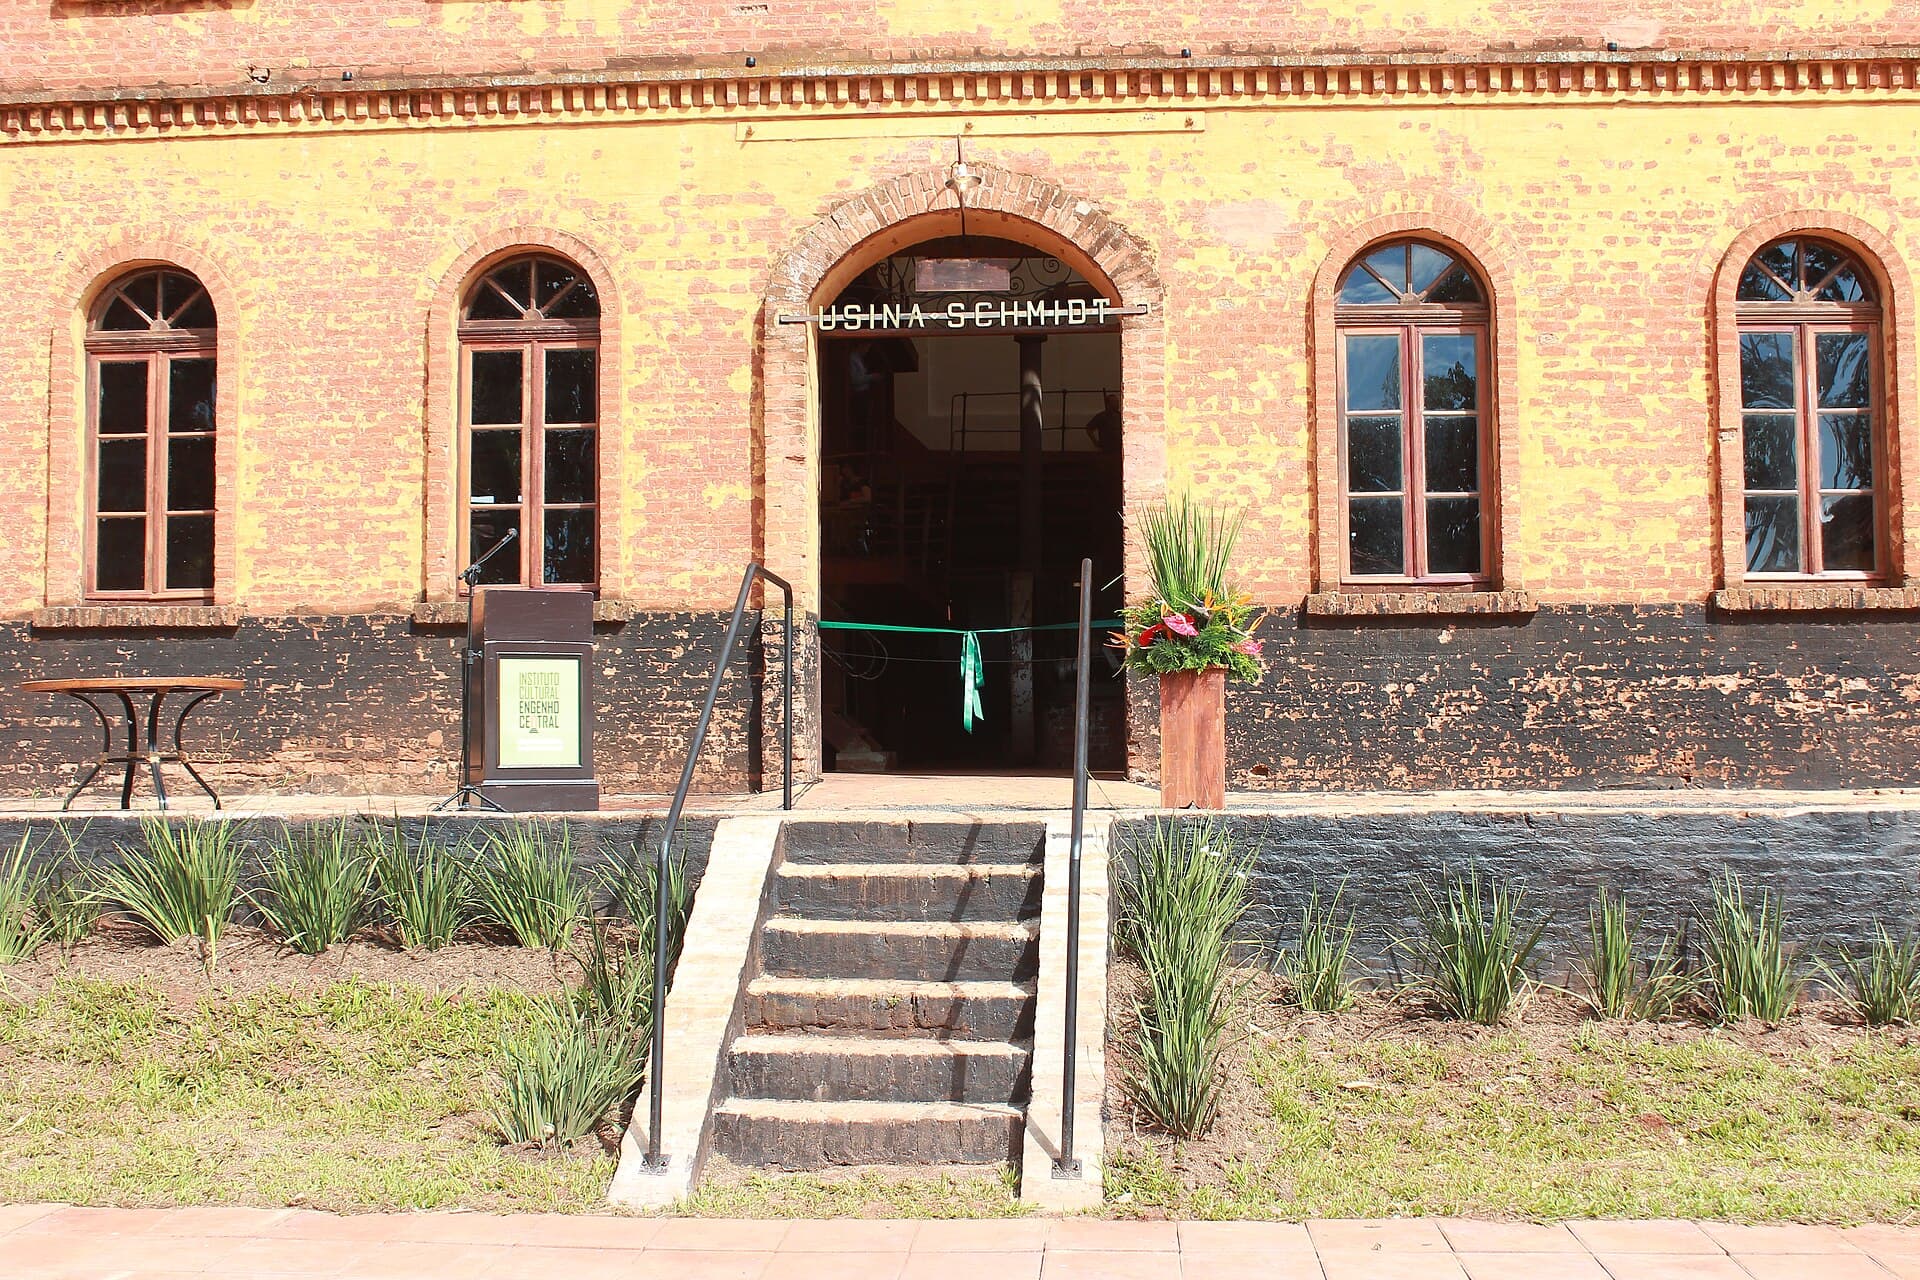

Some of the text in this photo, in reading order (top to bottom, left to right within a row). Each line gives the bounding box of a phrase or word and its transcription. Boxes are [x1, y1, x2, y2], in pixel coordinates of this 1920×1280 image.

[818, 298, 1110, 331] USINA SCHMIDT
[519, 672, 560, 685] INSTITUTO
[519, 686, 560, 699] CULTURAL
[519, 700, 560, 714] ENGENHO
